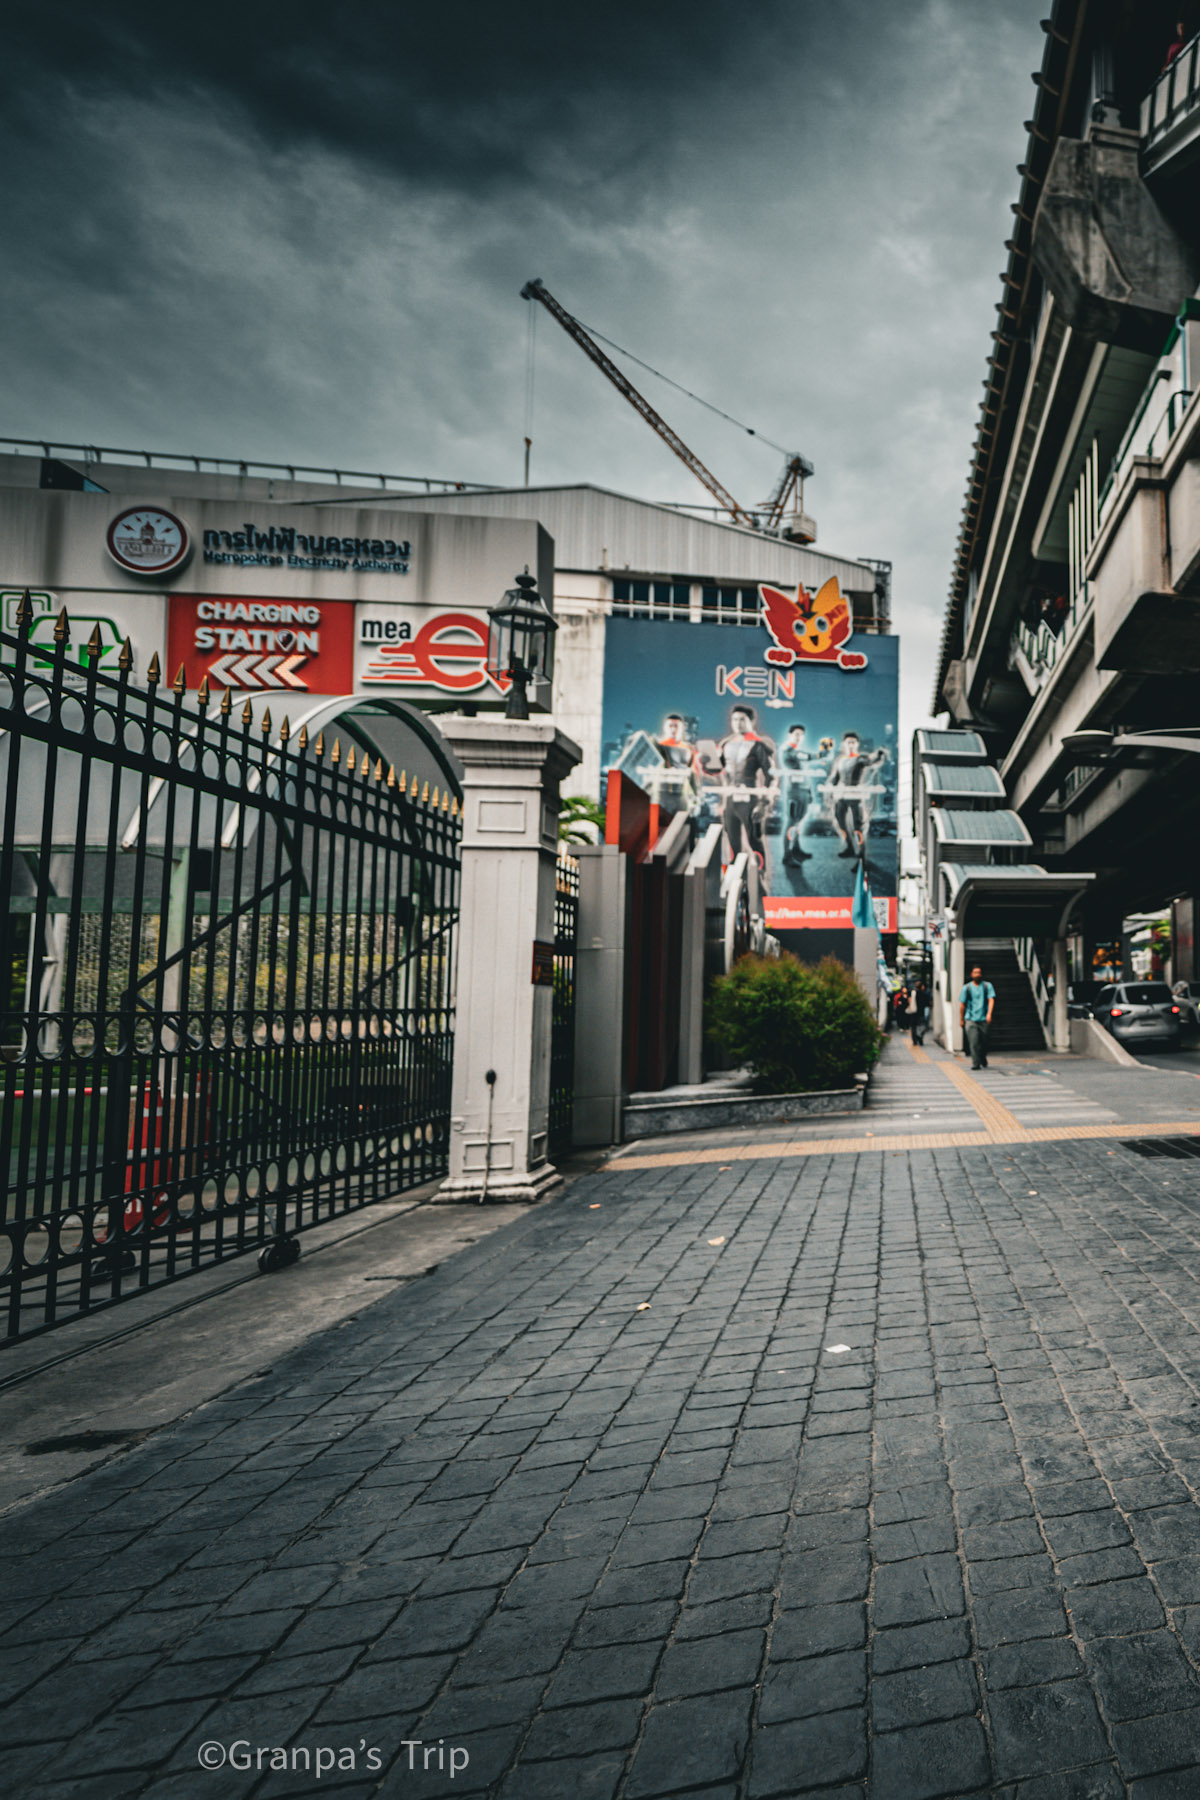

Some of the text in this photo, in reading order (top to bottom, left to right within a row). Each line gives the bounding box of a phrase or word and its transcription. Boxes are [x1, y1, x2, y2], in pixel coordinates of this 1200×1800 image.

[287, 554, 349, 571] Electricity
[352, 558, 410, 575] Authority
[197, 601, 322, 625] CHARGING
[195, 626, 320, 653] STATION
[361, 618, 412, 641] mea
[715, 664, 796, 699] KEN
